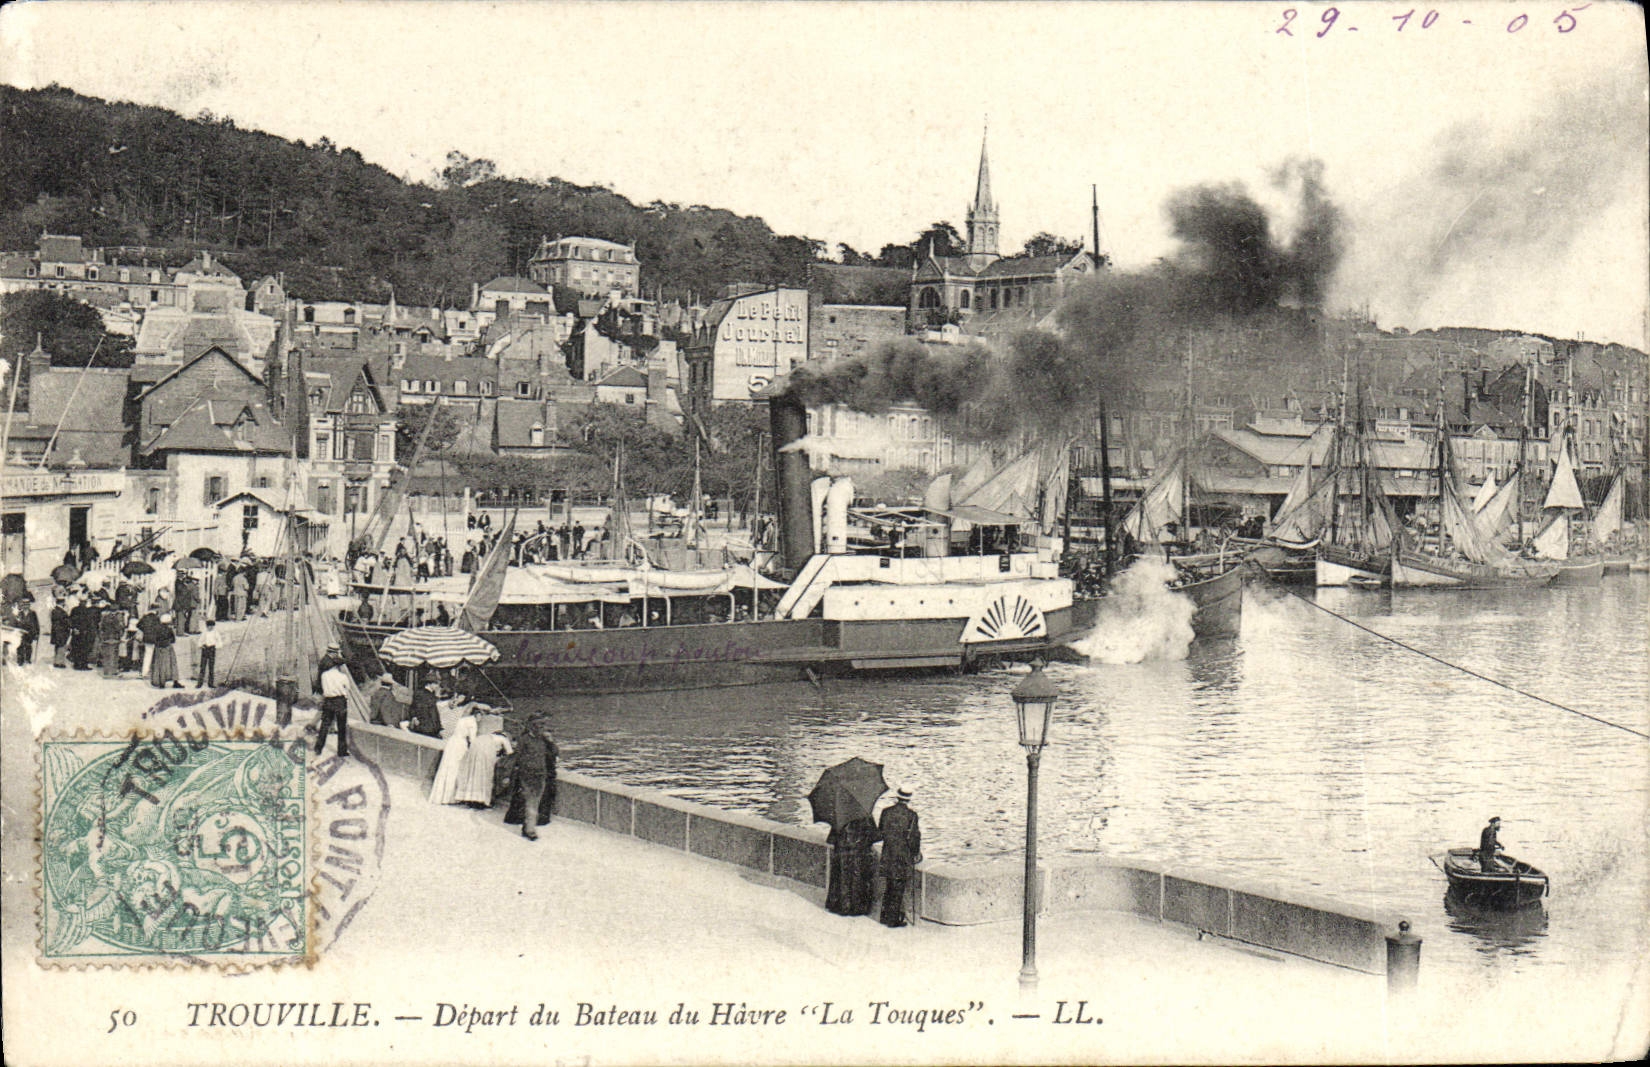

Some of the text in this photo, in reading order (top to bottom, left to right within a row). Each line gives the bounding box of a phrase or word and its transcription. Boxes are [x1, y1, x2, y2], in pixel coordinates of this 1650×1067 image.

[722, 322, 805, 344] Journal
[737, 299, 758, 320] Le
[277, 799, 304, 898] POSTES
[317, 783, 370, 902] PONT
